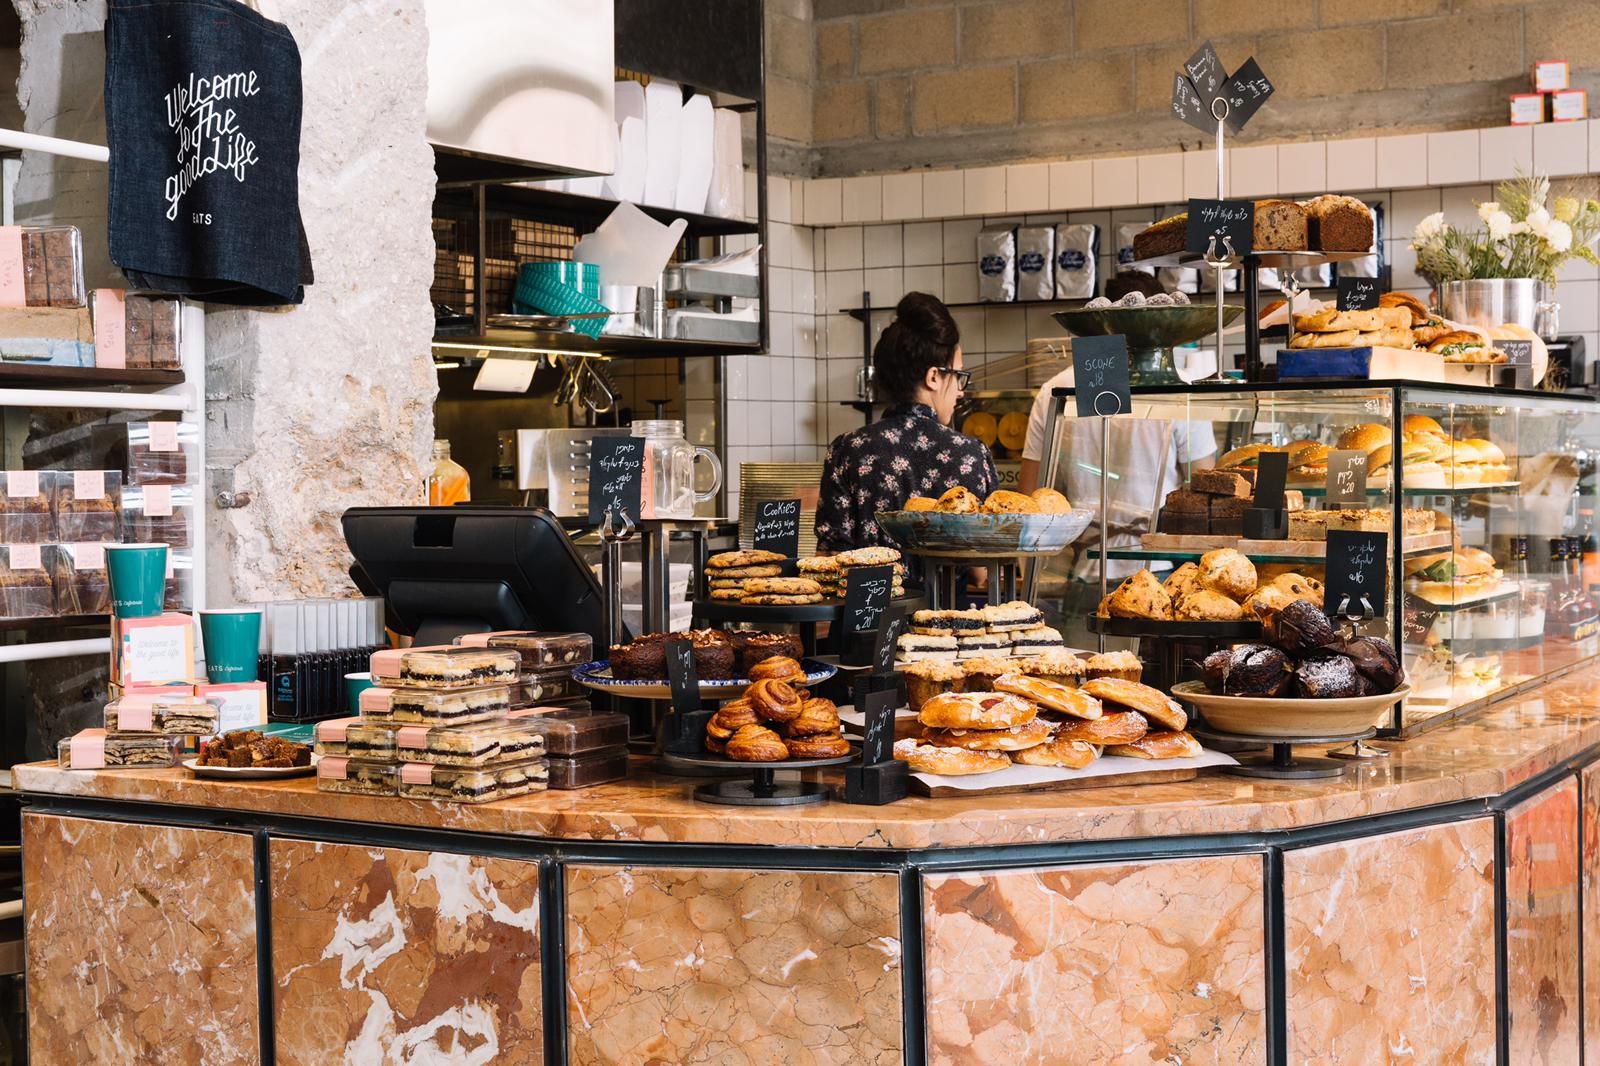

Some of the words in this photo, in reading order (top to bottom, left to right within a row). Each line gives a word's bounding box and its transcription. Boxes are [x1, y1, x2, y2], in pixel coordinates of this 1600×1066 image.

[164, 70, 260, 128] Welcome
[192, 212, 212, 225] EATS
[1084, 356, 1116, 371] SCONE
